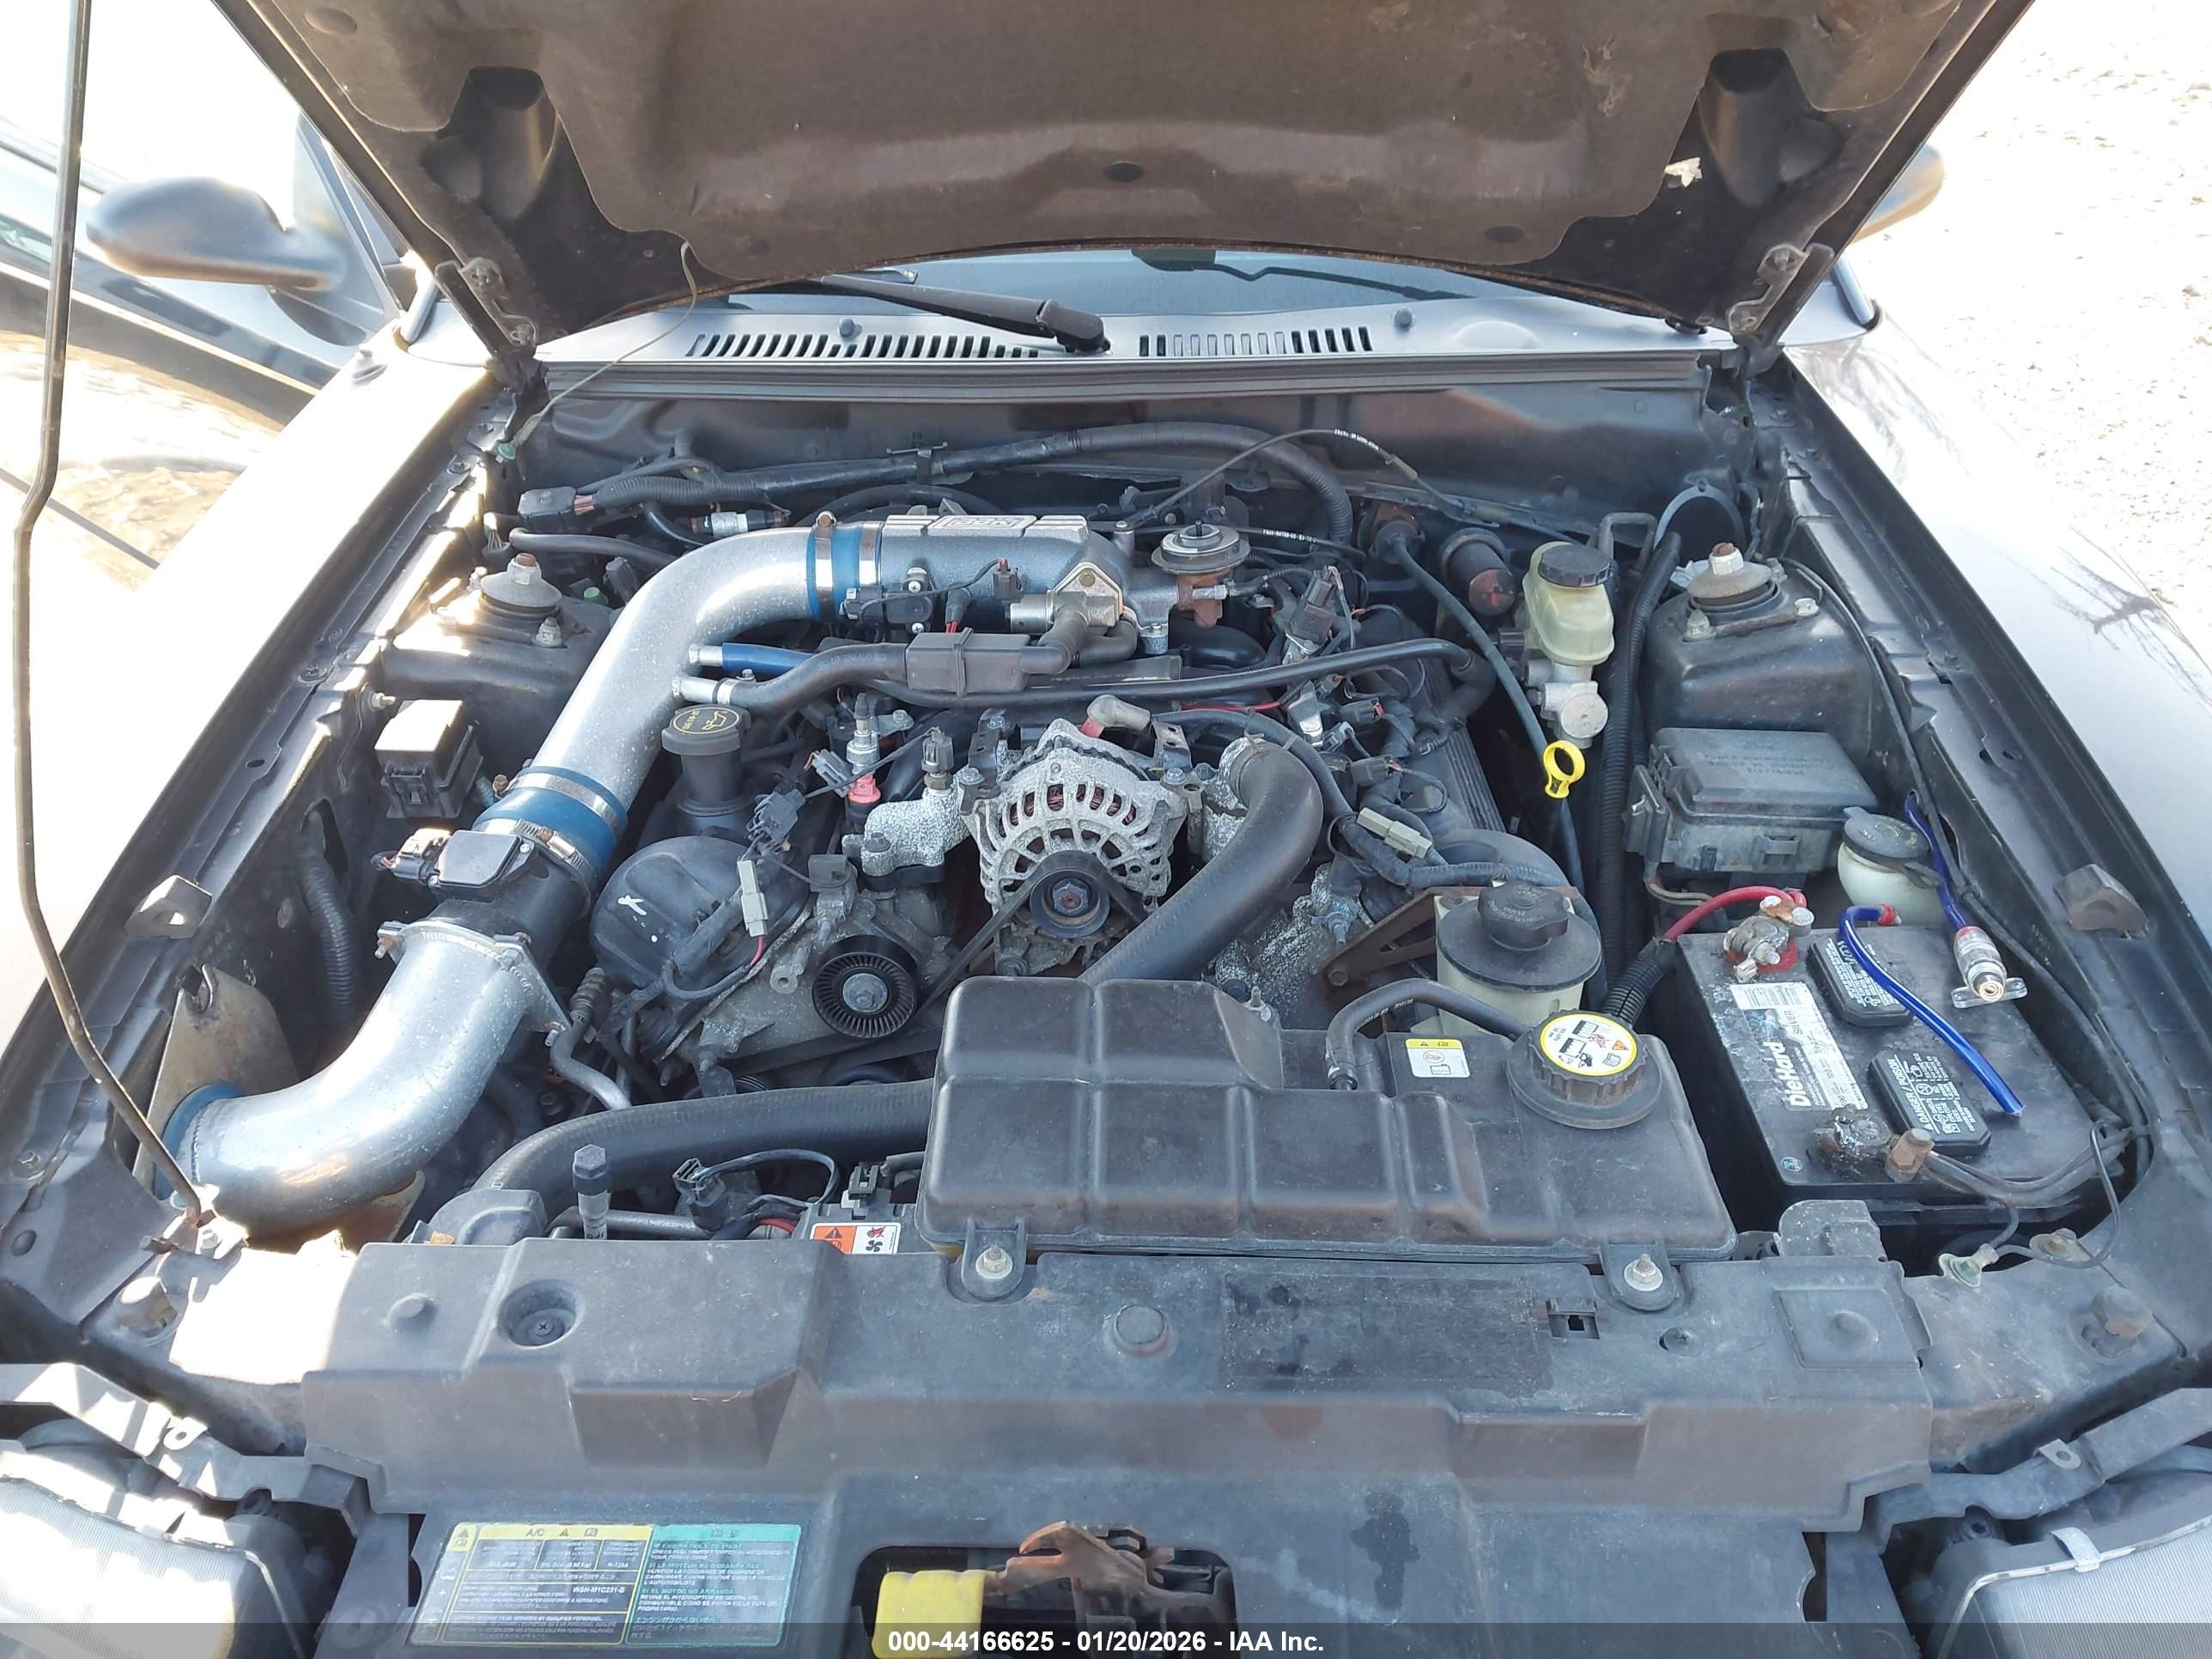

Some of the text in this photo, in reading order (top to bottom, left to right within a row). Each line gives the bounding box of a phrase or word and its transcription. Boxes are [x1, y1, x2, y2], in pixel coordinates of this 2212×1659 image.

[1762, 1041, 1812, 1107] DieHard
[1887, 1059, 1909, 1086] POISON
[1905, 1092, 1930, 1123] DANGER
[526, 1528, 545, 1537] A/C
